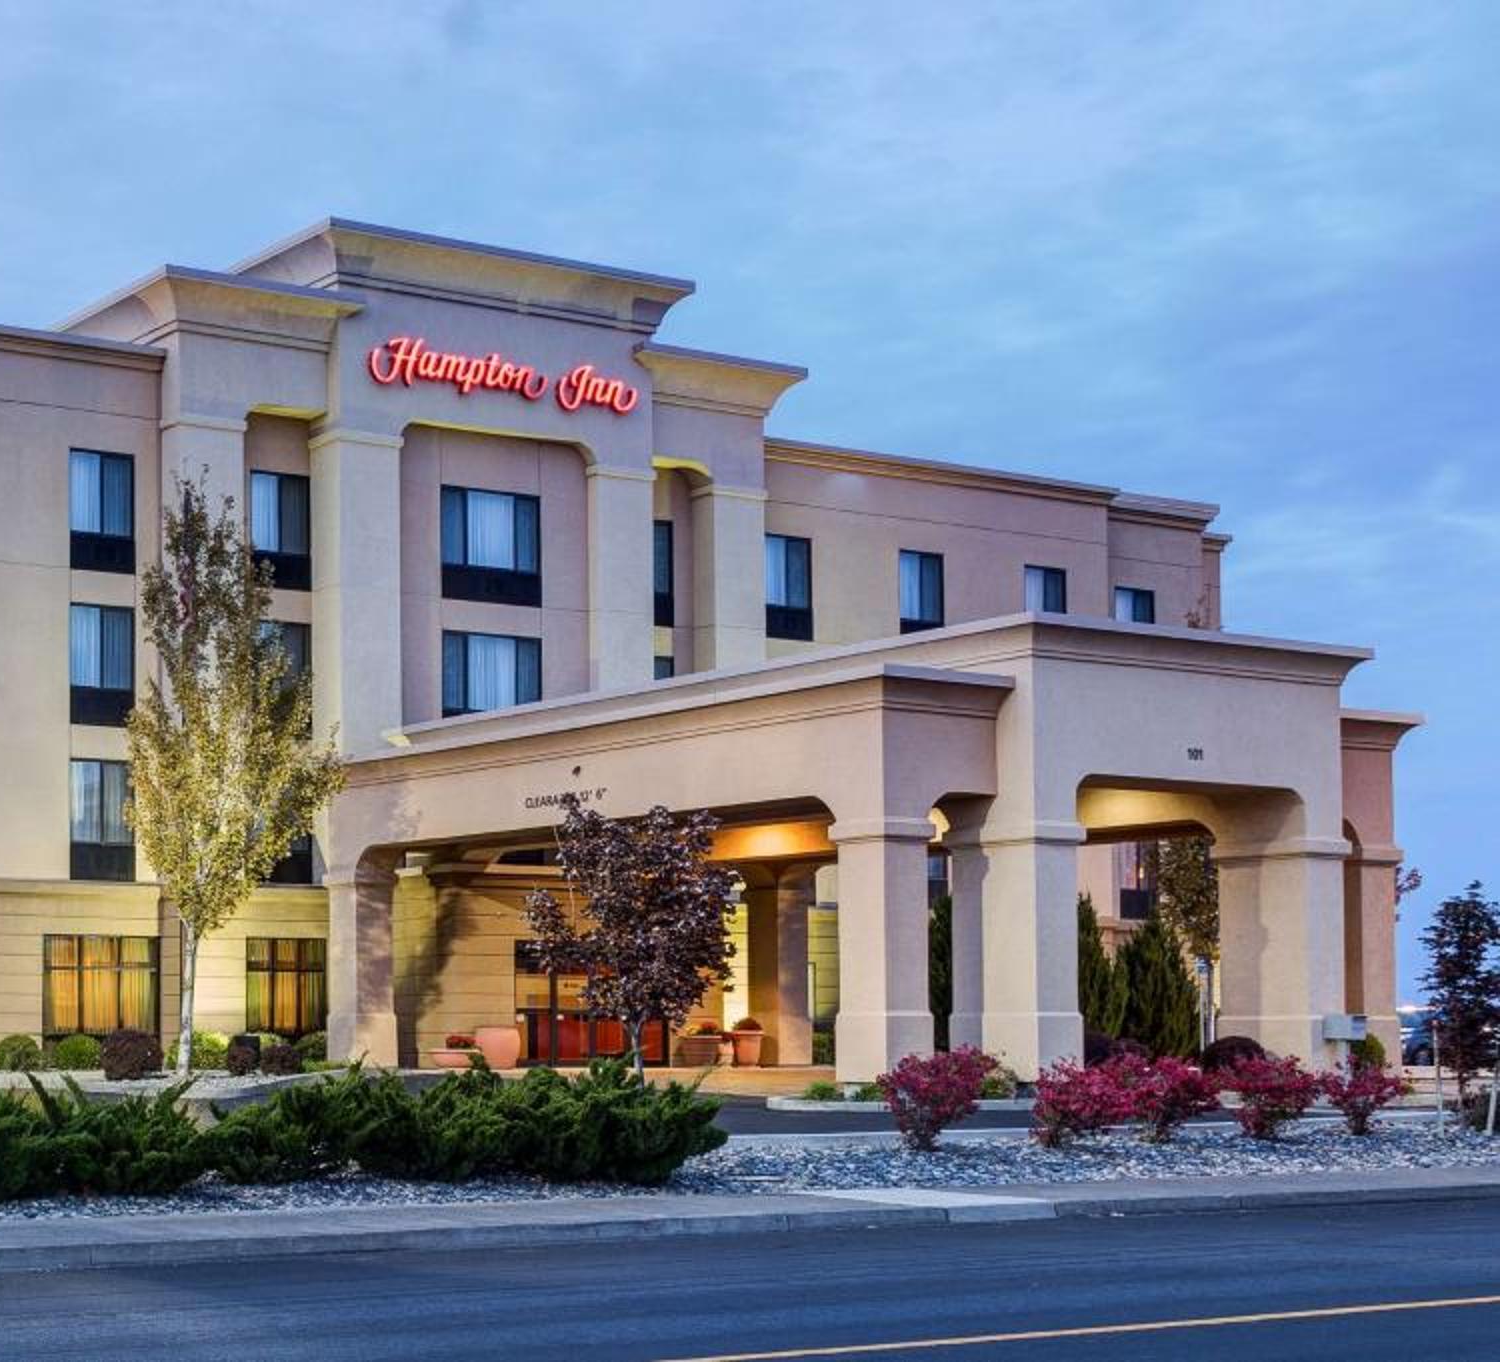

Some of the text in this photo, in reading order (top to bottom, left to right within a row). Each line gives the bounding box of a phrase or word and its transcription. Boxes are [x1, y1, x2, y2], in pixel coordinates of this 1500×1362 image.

[368, 335, 638, 412] Hampton Inn
[1187, 747, 1204, 761] 101
[524, 792, 577, 809] CLEARA
